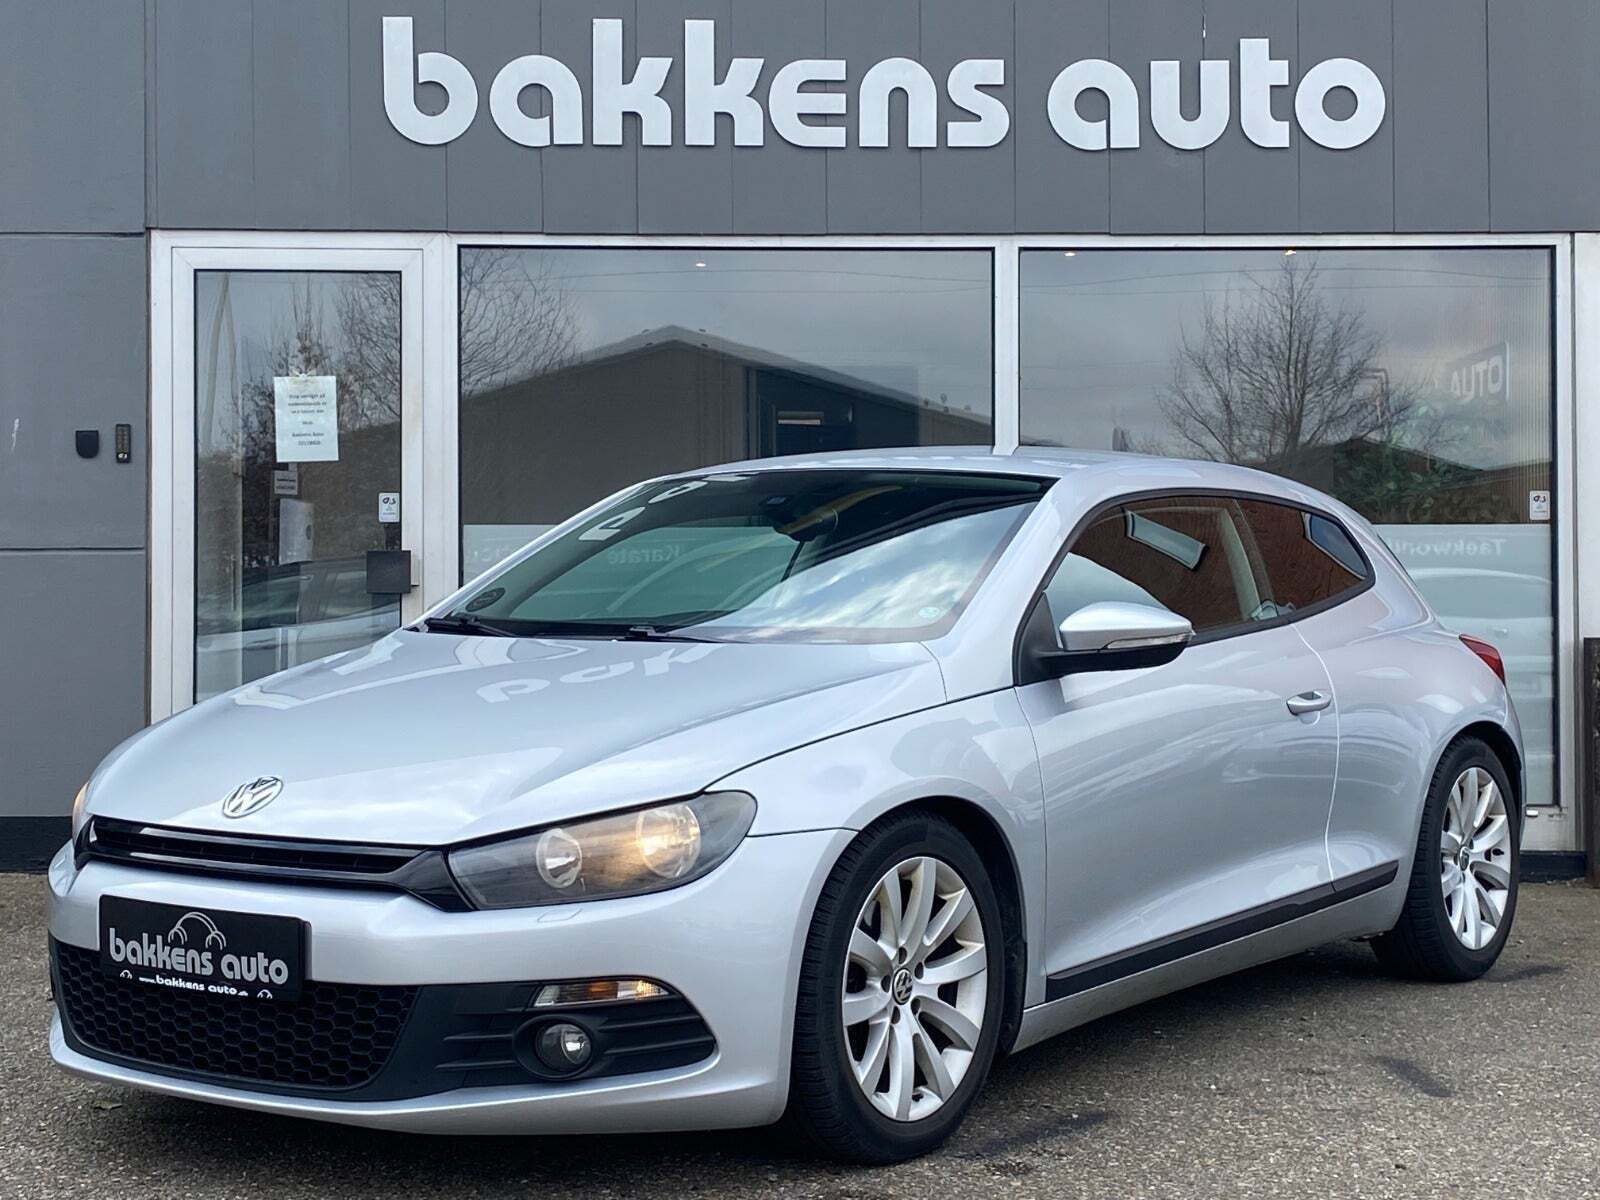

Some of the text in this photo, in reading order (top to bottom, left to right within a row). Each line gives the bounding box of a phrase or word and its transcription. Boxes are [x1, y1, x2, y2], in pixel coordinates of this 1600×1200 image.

[382, 16, 1386, 150] bakkens auto
[1450, 354, 1504, 400] AUTO
[109, 927, 289, 984] bakkens auto
